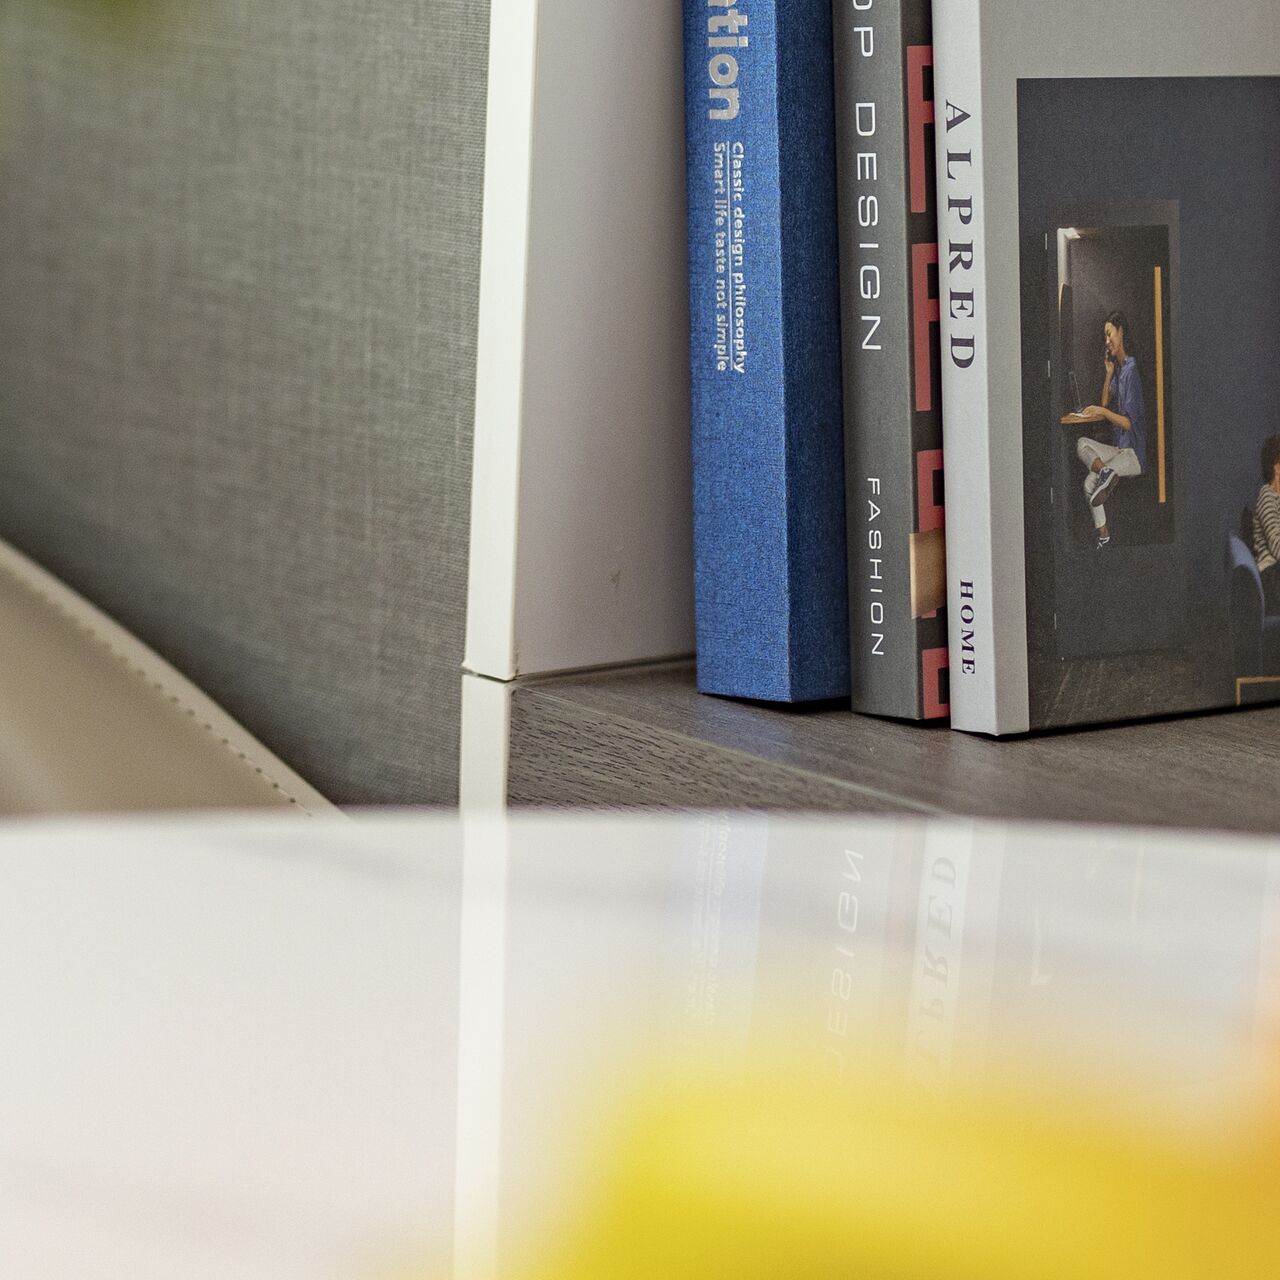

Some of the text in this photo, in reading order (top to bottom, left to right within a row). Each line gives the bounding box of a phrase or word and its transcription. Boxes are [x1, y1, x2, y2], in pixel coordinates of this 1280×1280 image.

[713, 142, 730, 372] Smart life taste not simple
[732, 141, 748, 374] Classic design philosophy
[855, 102, 882, 351] DESIGN
[945, 99, 976, 370] ALPRED
[867, 477, 885, 656] FASHION
[959, 579, 976, 675] HOME
